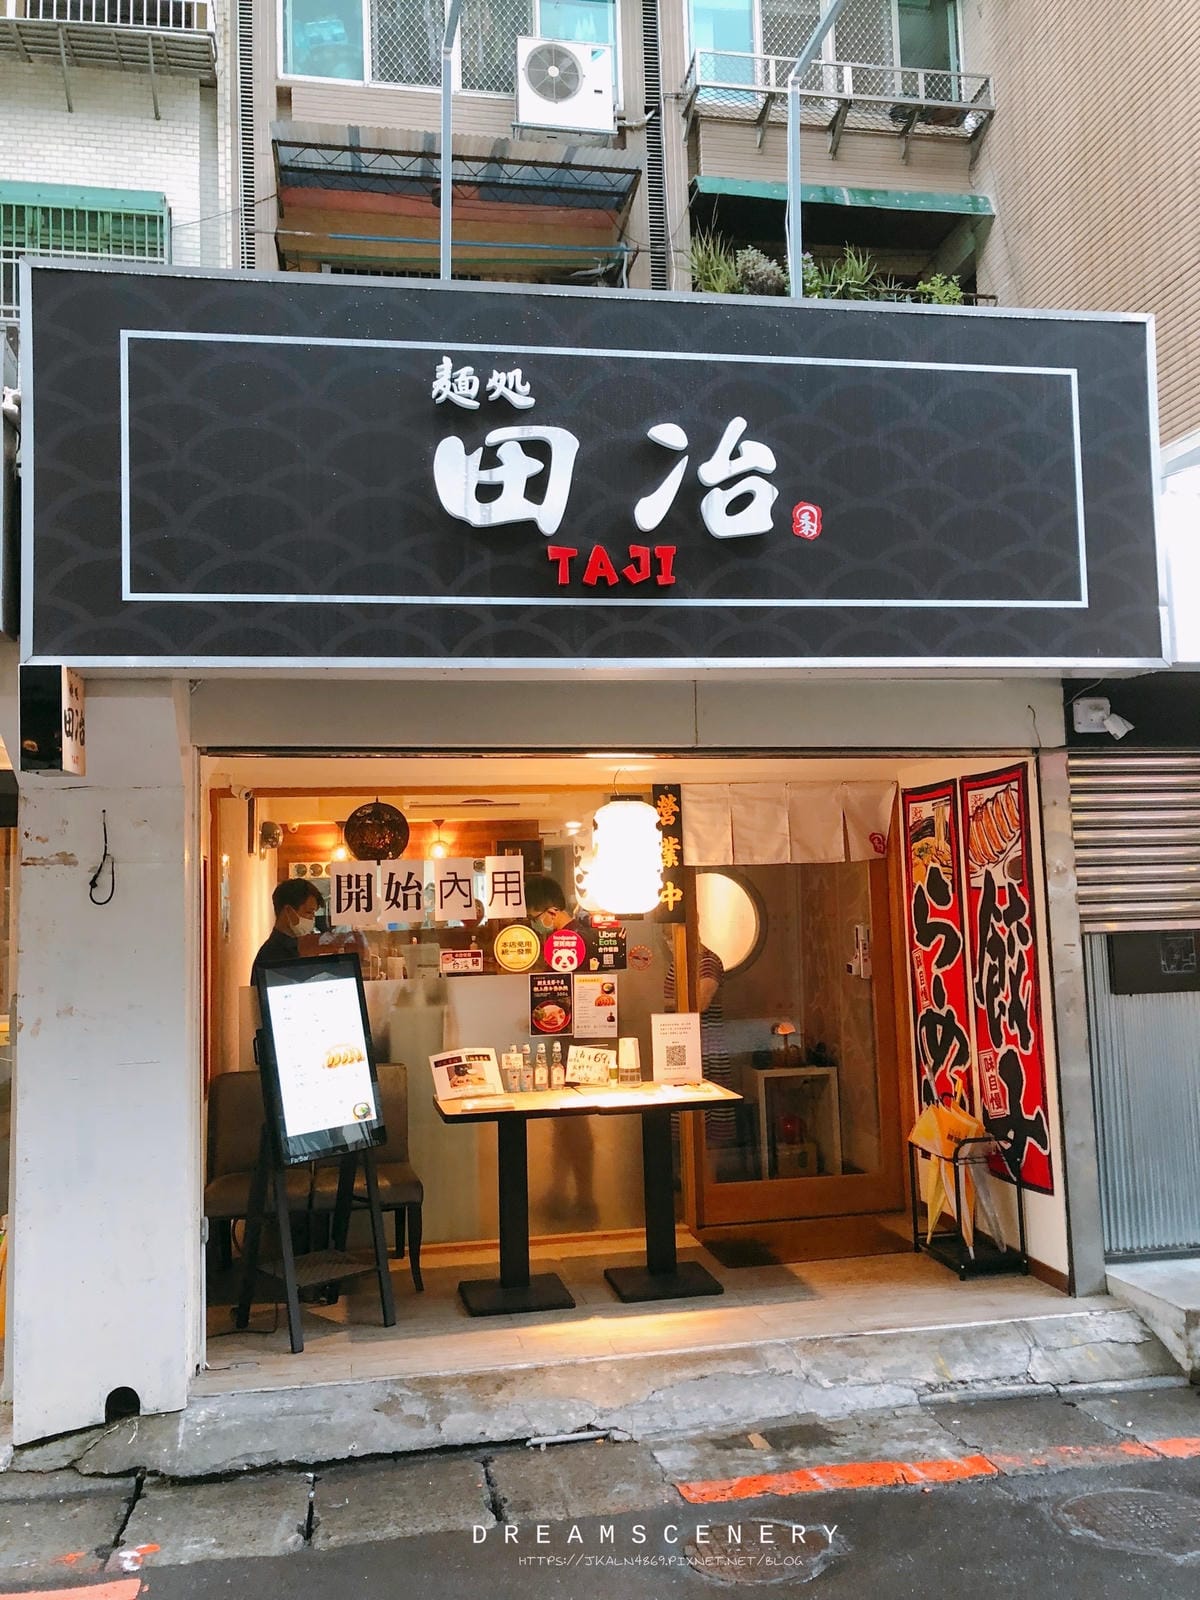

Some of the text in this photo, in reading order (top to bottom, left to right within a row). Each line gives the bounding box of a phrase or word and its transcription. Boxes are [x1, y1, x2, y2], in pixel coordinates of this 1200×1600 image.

[433, 416, 779, 539] 田冶
[547, 544, 678, 587] TAJI
[598, 930, 617, 938] Uber
[598, 938, 617, 946] Eats
[983, 1055, 1003, 1111] 味自慢
